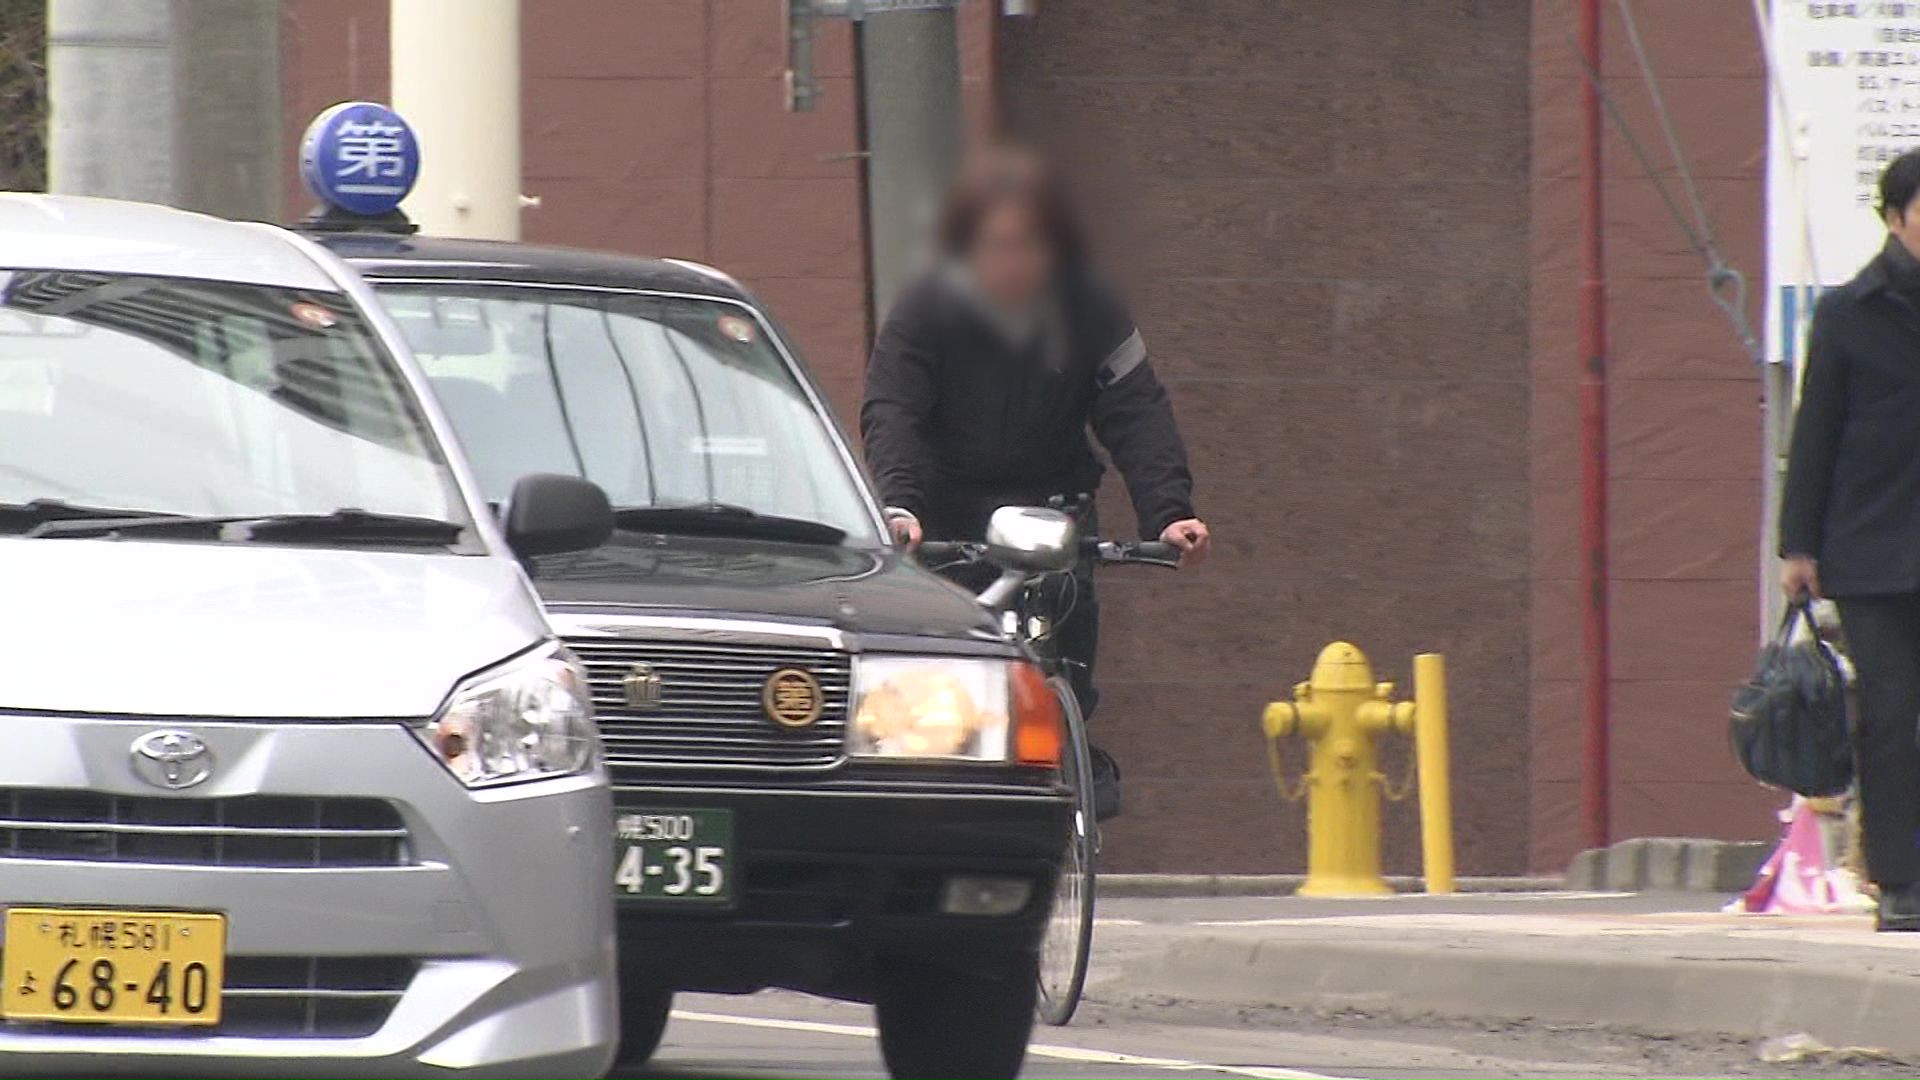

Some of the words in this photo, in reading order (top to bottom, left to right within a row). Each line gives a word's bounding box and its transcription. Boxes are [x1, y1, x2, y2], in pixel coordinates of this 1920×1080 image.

[334, 119, 405, 195] 第一
[615, 846, 725, 895] 4-35
[18, 970, 37, 996] よ
[53, 958, 208, 1015] 68-40
